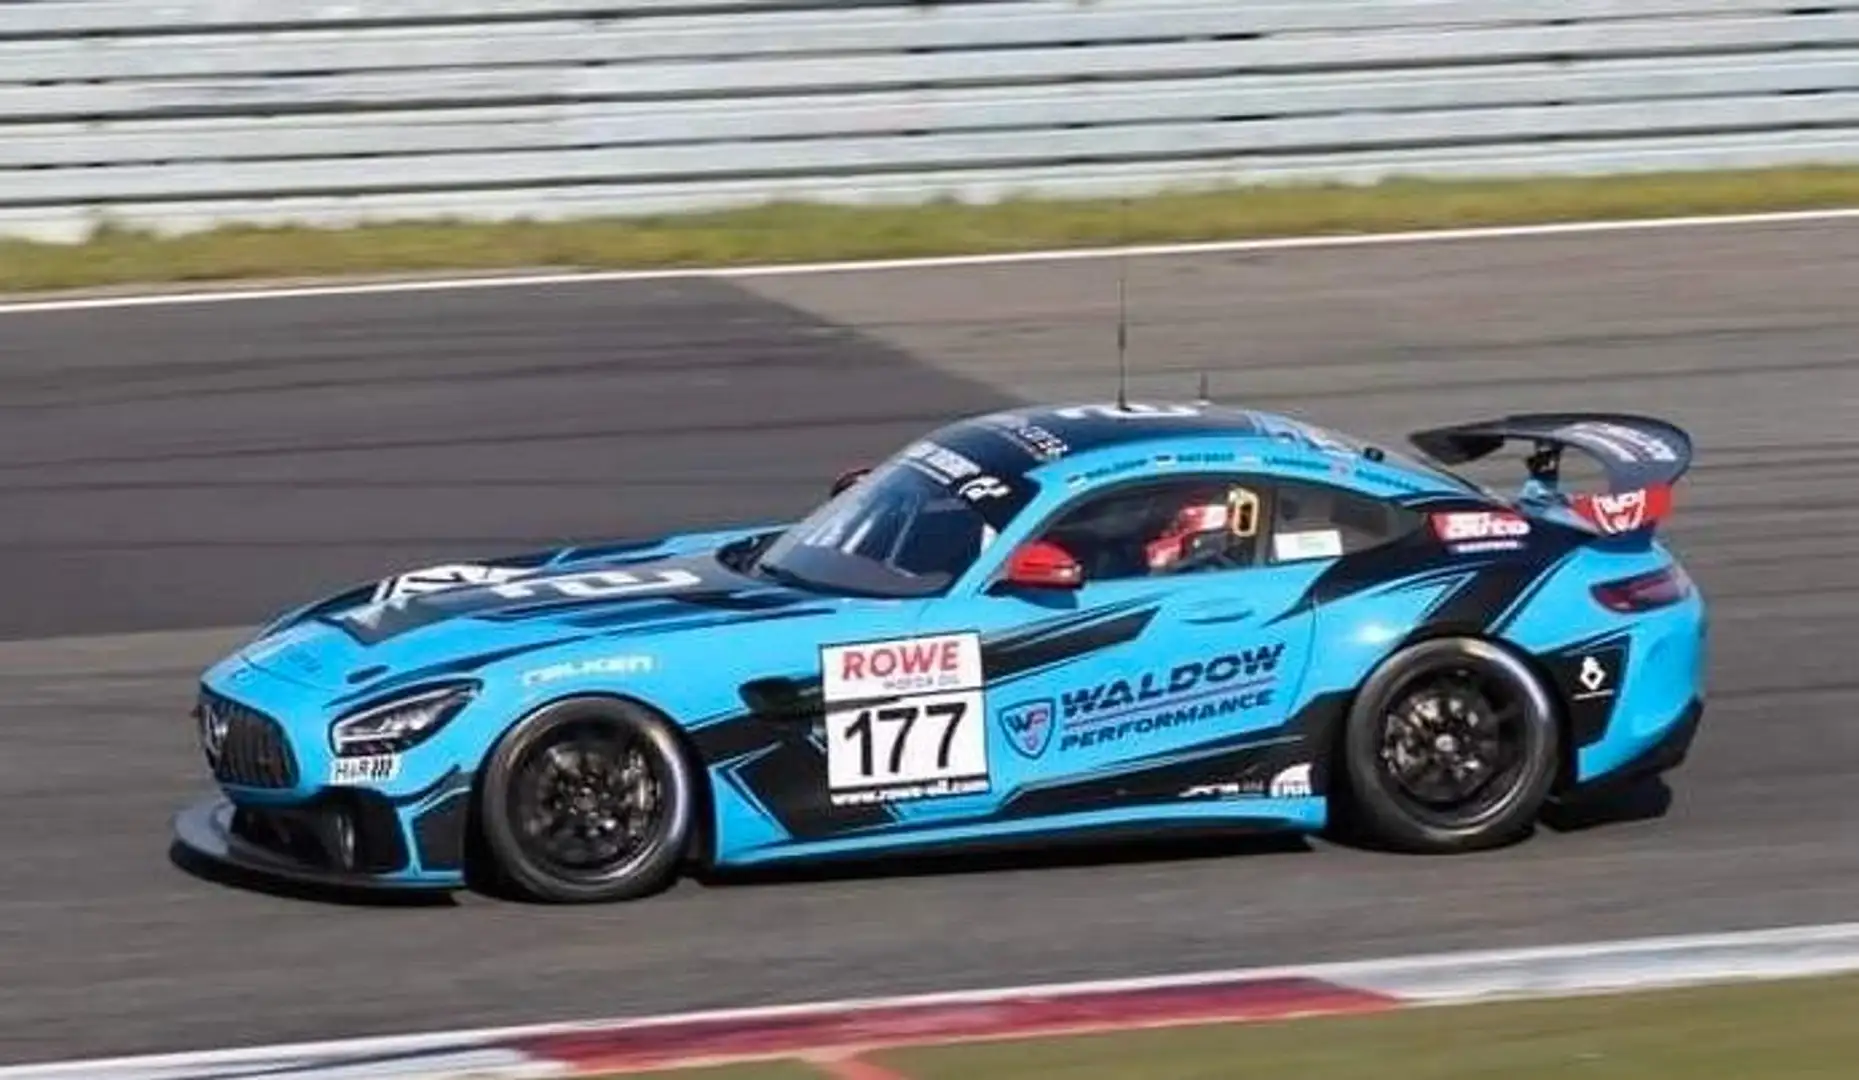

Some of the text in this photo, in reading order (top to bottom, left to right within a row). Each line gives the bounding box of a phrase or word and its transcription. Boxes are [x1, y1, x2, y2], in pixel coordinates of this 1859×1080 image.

[841, 640, 960, 681] ROWE
[1060, 643, 1286, 719] WALDOW
[844, 702, 968, 777] 177
[1060, 689, 1275, 752] PERFORMANCE
